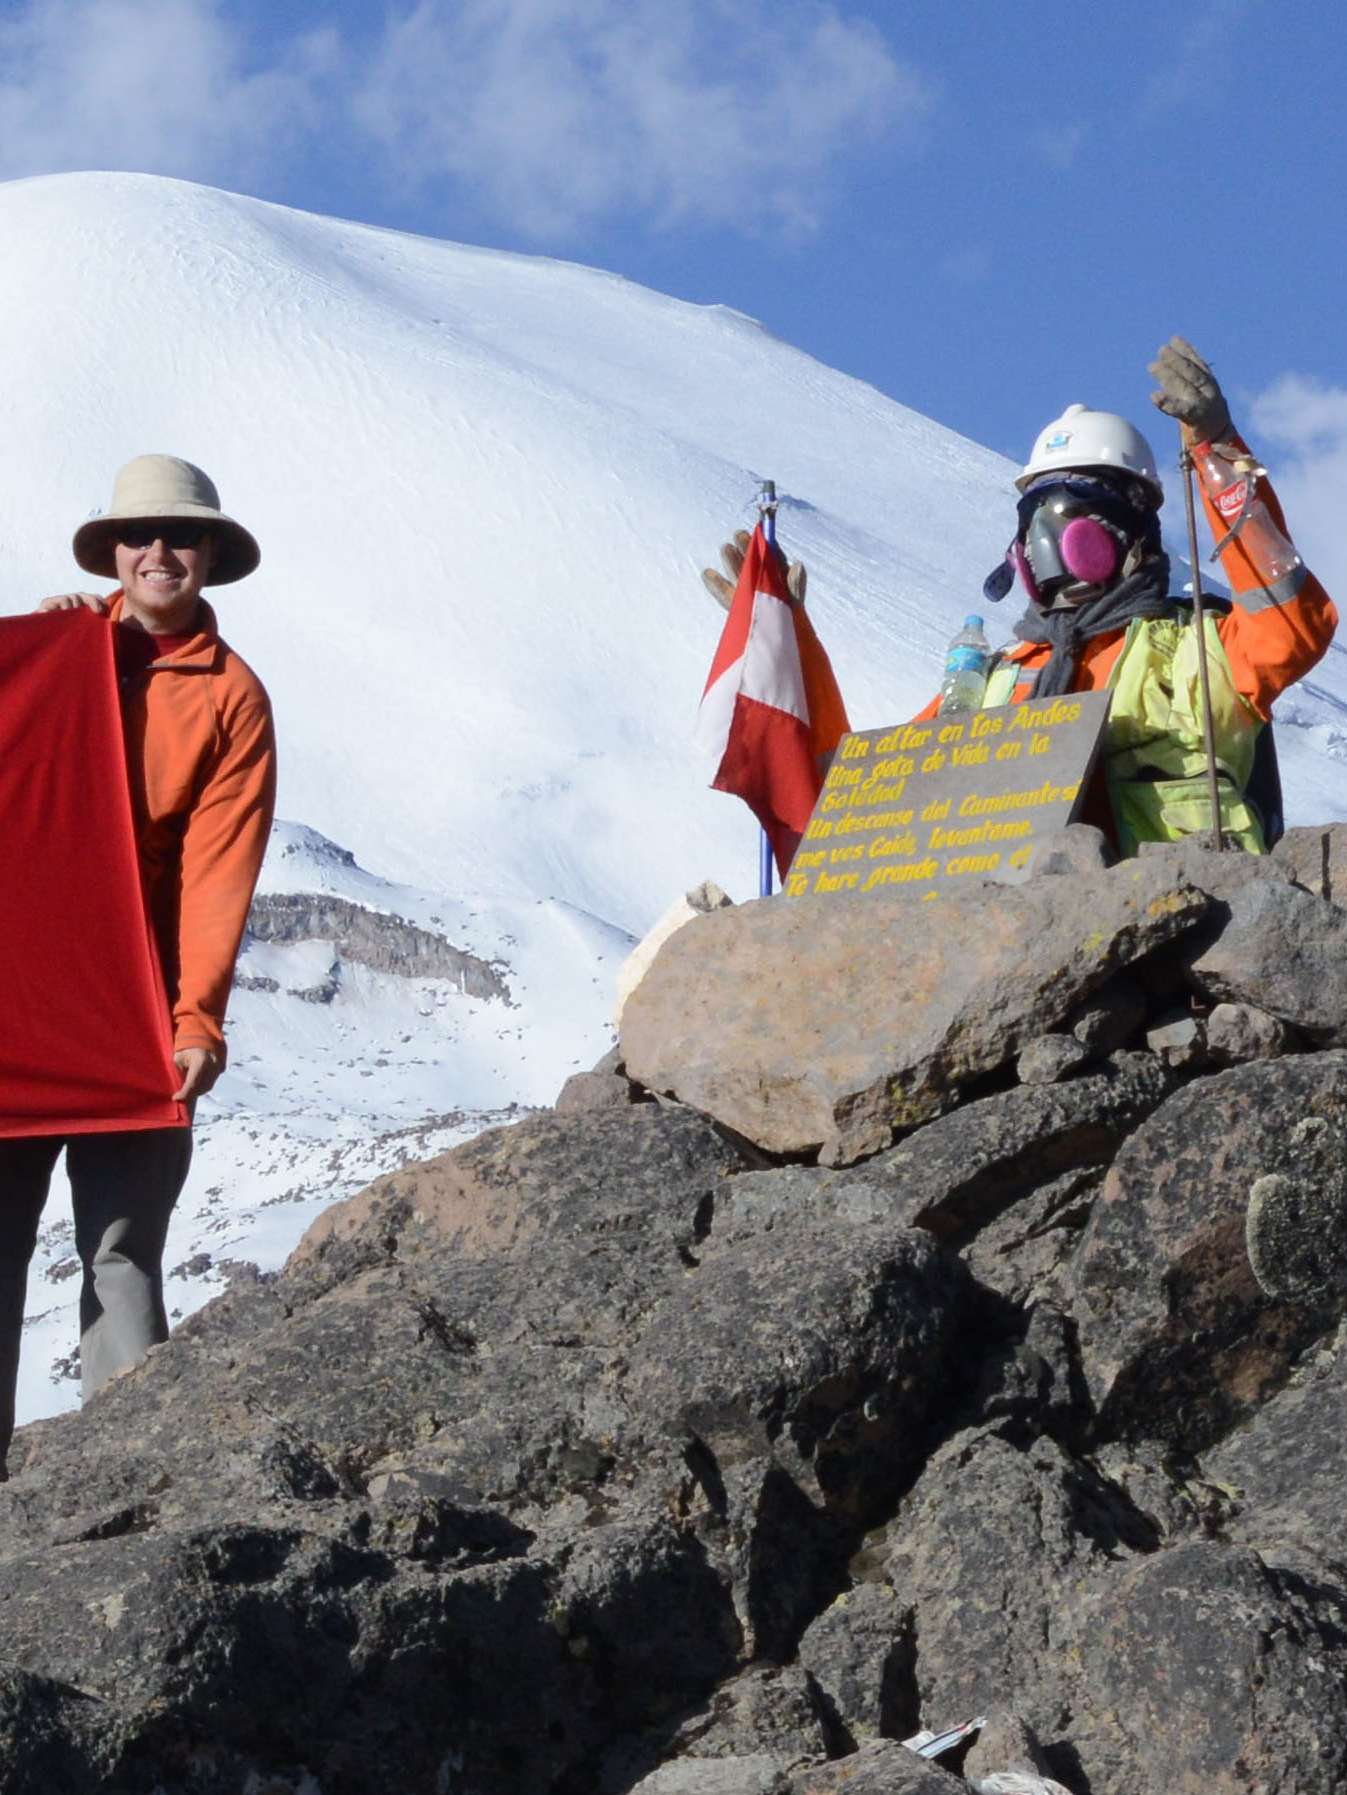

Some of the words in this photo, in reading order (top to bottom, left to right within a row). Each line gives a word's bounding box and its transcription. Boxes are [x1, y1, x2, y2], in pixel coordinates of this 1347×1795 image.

[842, 737, 869, 758] Un
[877, 725, 932, 752] altar
[939, 724, 963, 743] en
[973, 714, 1002, 737] los
[1009, 700, 1080, 731] Andes
[828, 766, 863, 787] Una
[863, 756, 915, 789] gota
[922, 749, 946, 772] de
[953, 742, 989, 766] Vida
[996, 740, 1019, 759] en
[1031, 734, 1050, 754] la
[808, 820, 833, 839] Un
[836, 810, 915, 835] descanso
[922, 798, 952, 820] del
[959, 782, 1061, 816] Caminante
[787, 874, 809, 897] Te
[861, 857, 939, 891] grande
[947, 854, 1001, 875] como
[796, 851, 827, 868] me
[831, 845, 865, 863] ves
